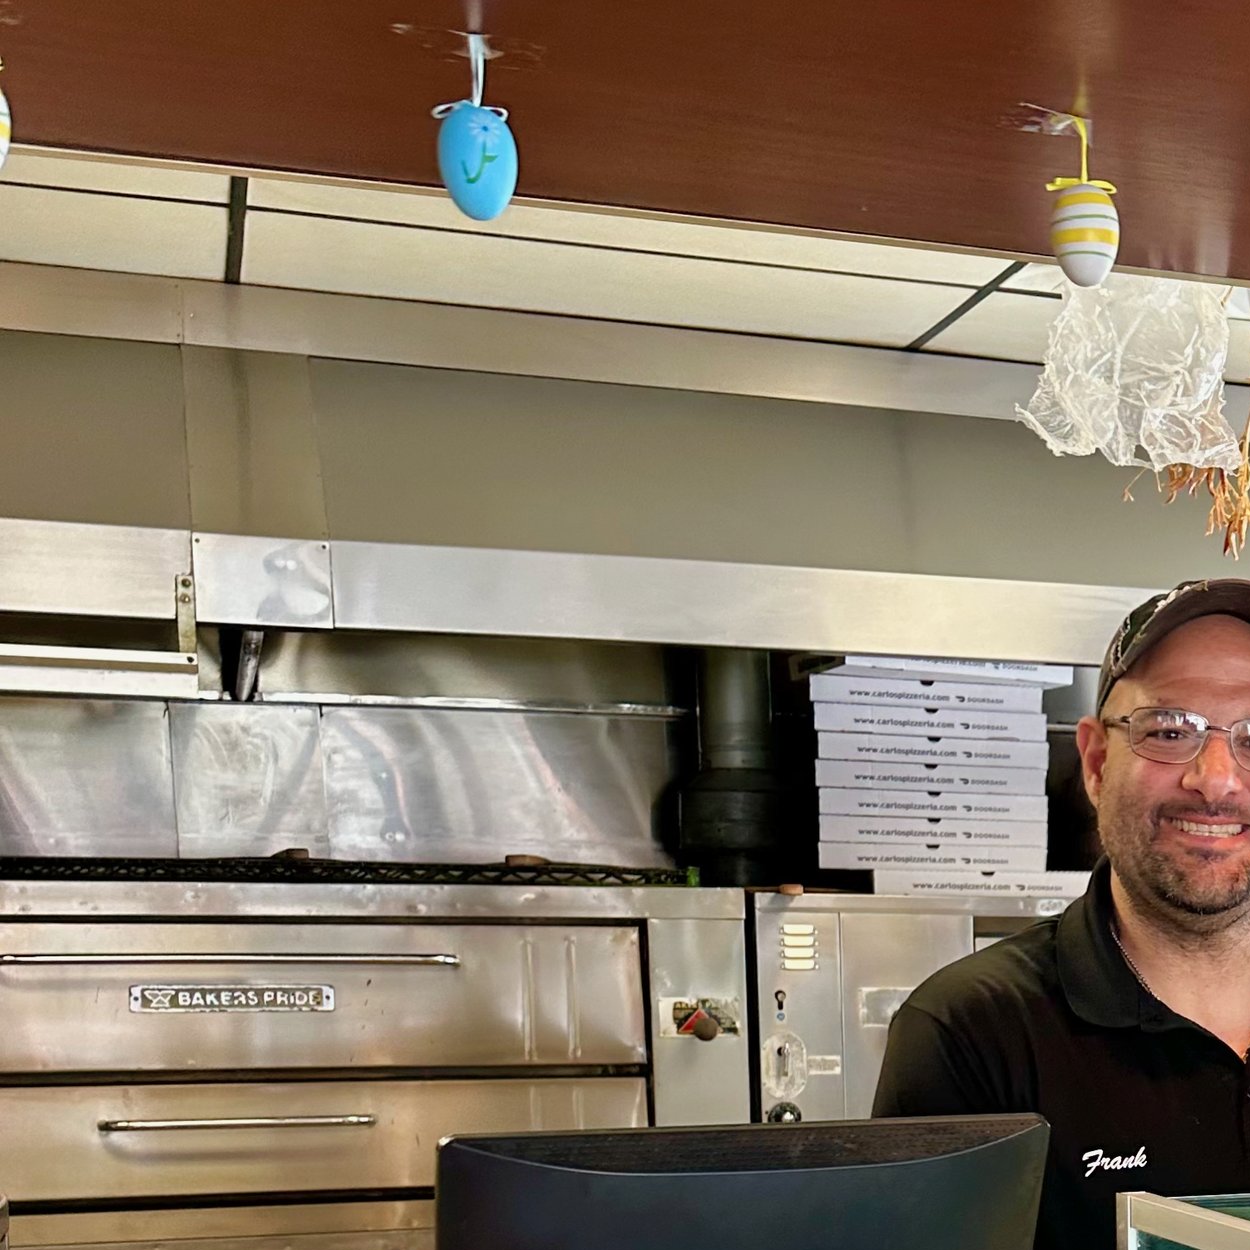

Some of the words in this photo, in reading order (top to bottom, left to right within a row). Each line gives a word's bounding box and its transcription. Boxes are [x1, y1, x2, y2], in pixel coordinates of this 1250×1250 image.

[178, 991, 258, 1006] BAKERS
[263, 990, 321, 1006] PRIDE
[1081, 1145, 1147, 1178] Frank
